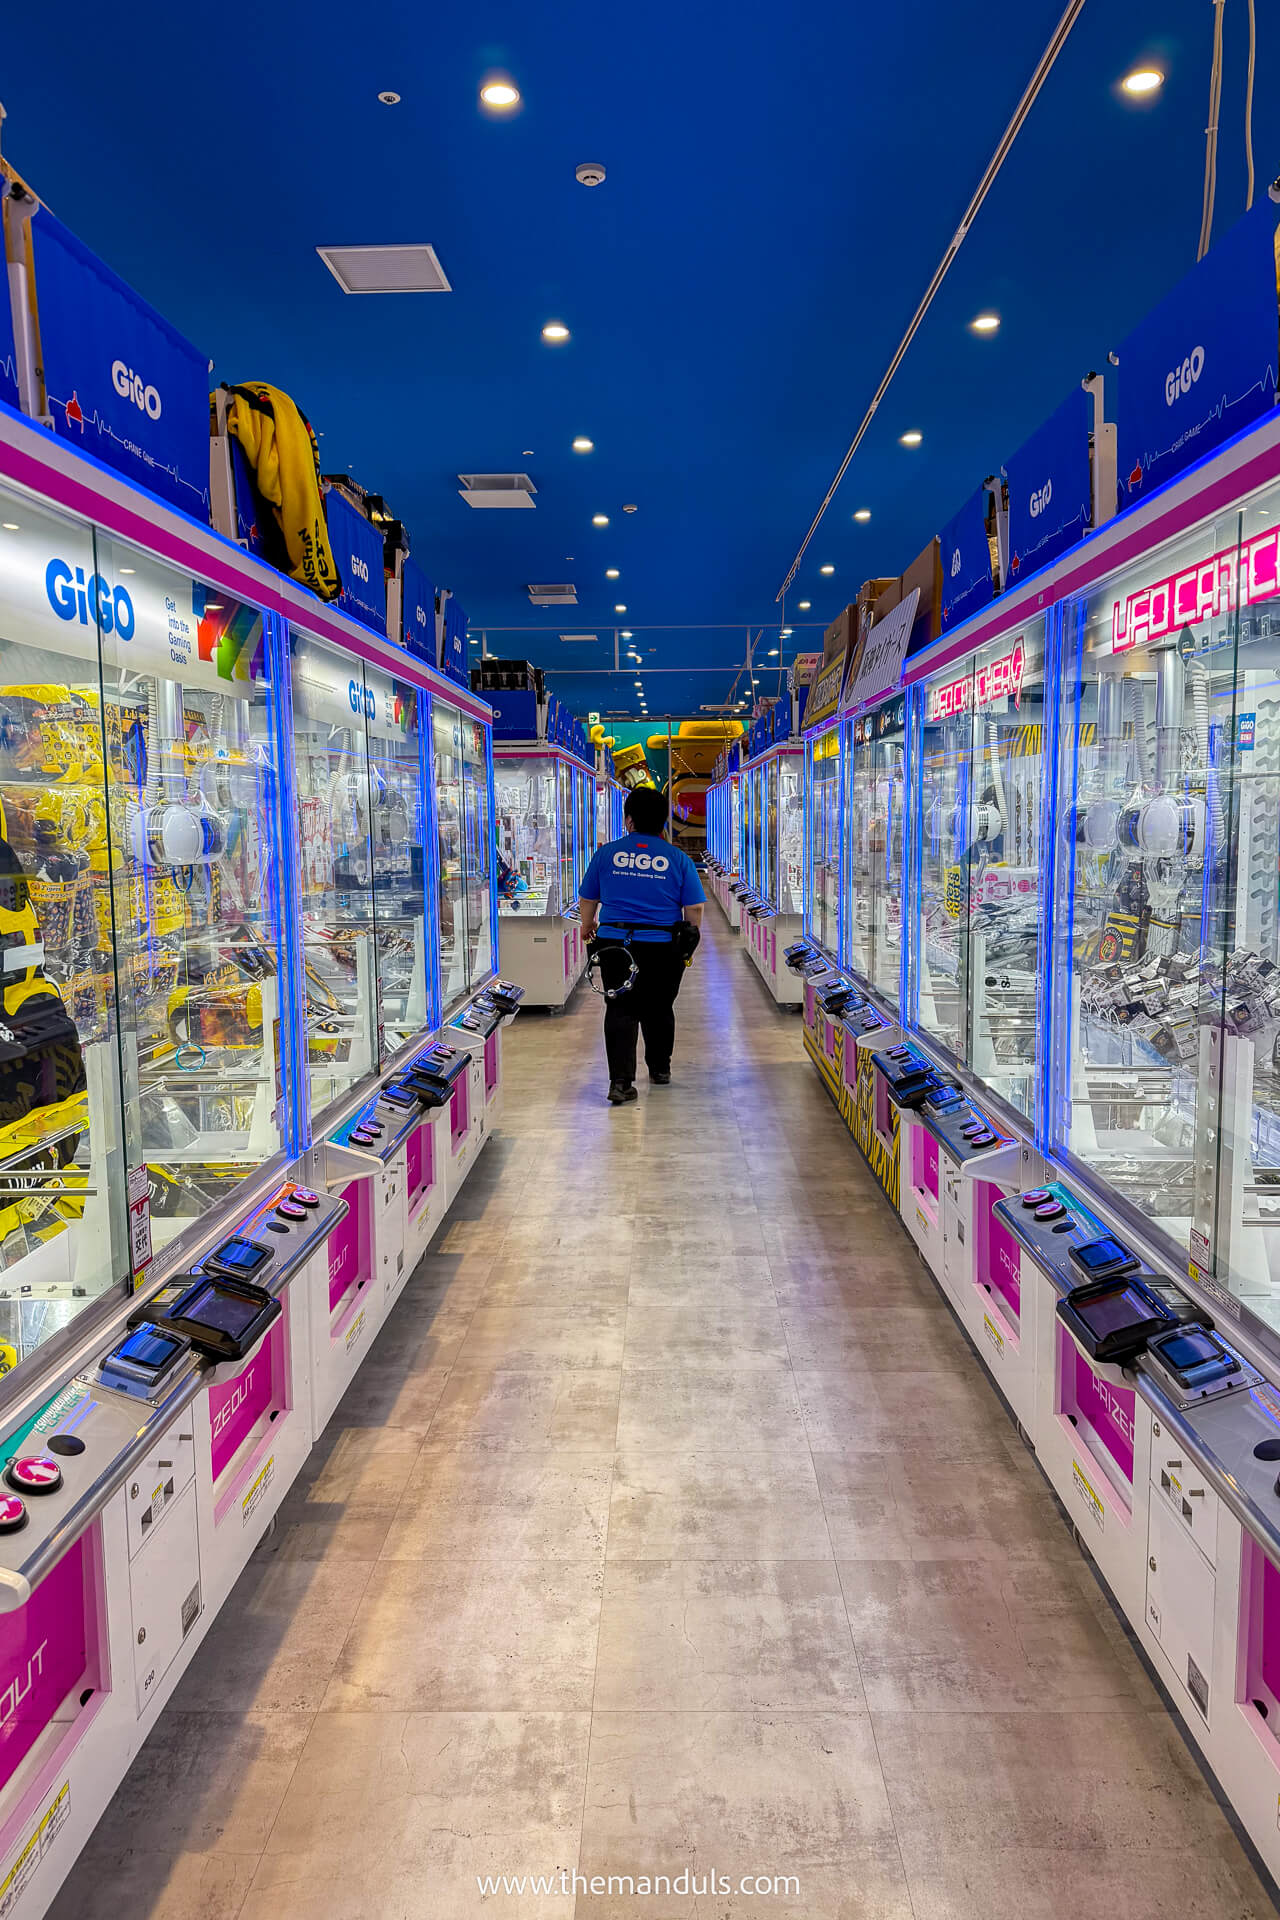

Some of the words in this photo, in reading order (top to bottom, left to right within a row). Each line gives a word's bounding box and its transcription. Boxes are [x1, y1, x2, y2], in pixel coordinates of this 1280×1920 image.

[112, 360, 162, 420] GiGO
[1165, 345, 1205, 406] GiGO
[351, 554, 369, 583] GiGO
[45, 558, 135, 641] GiGO
[165, 596, 177, 613] Get
[168, 617, 179, 630] into
[179, 619, 190, 634] the
[1113, 582, 1170, 653] UFO
[168, 633, 191, 654] Gaming
[170, 648, 188, 665] Oasis
[348, 679, 376, 721] GiGO
[613, 851, 669, 871] GiGO
